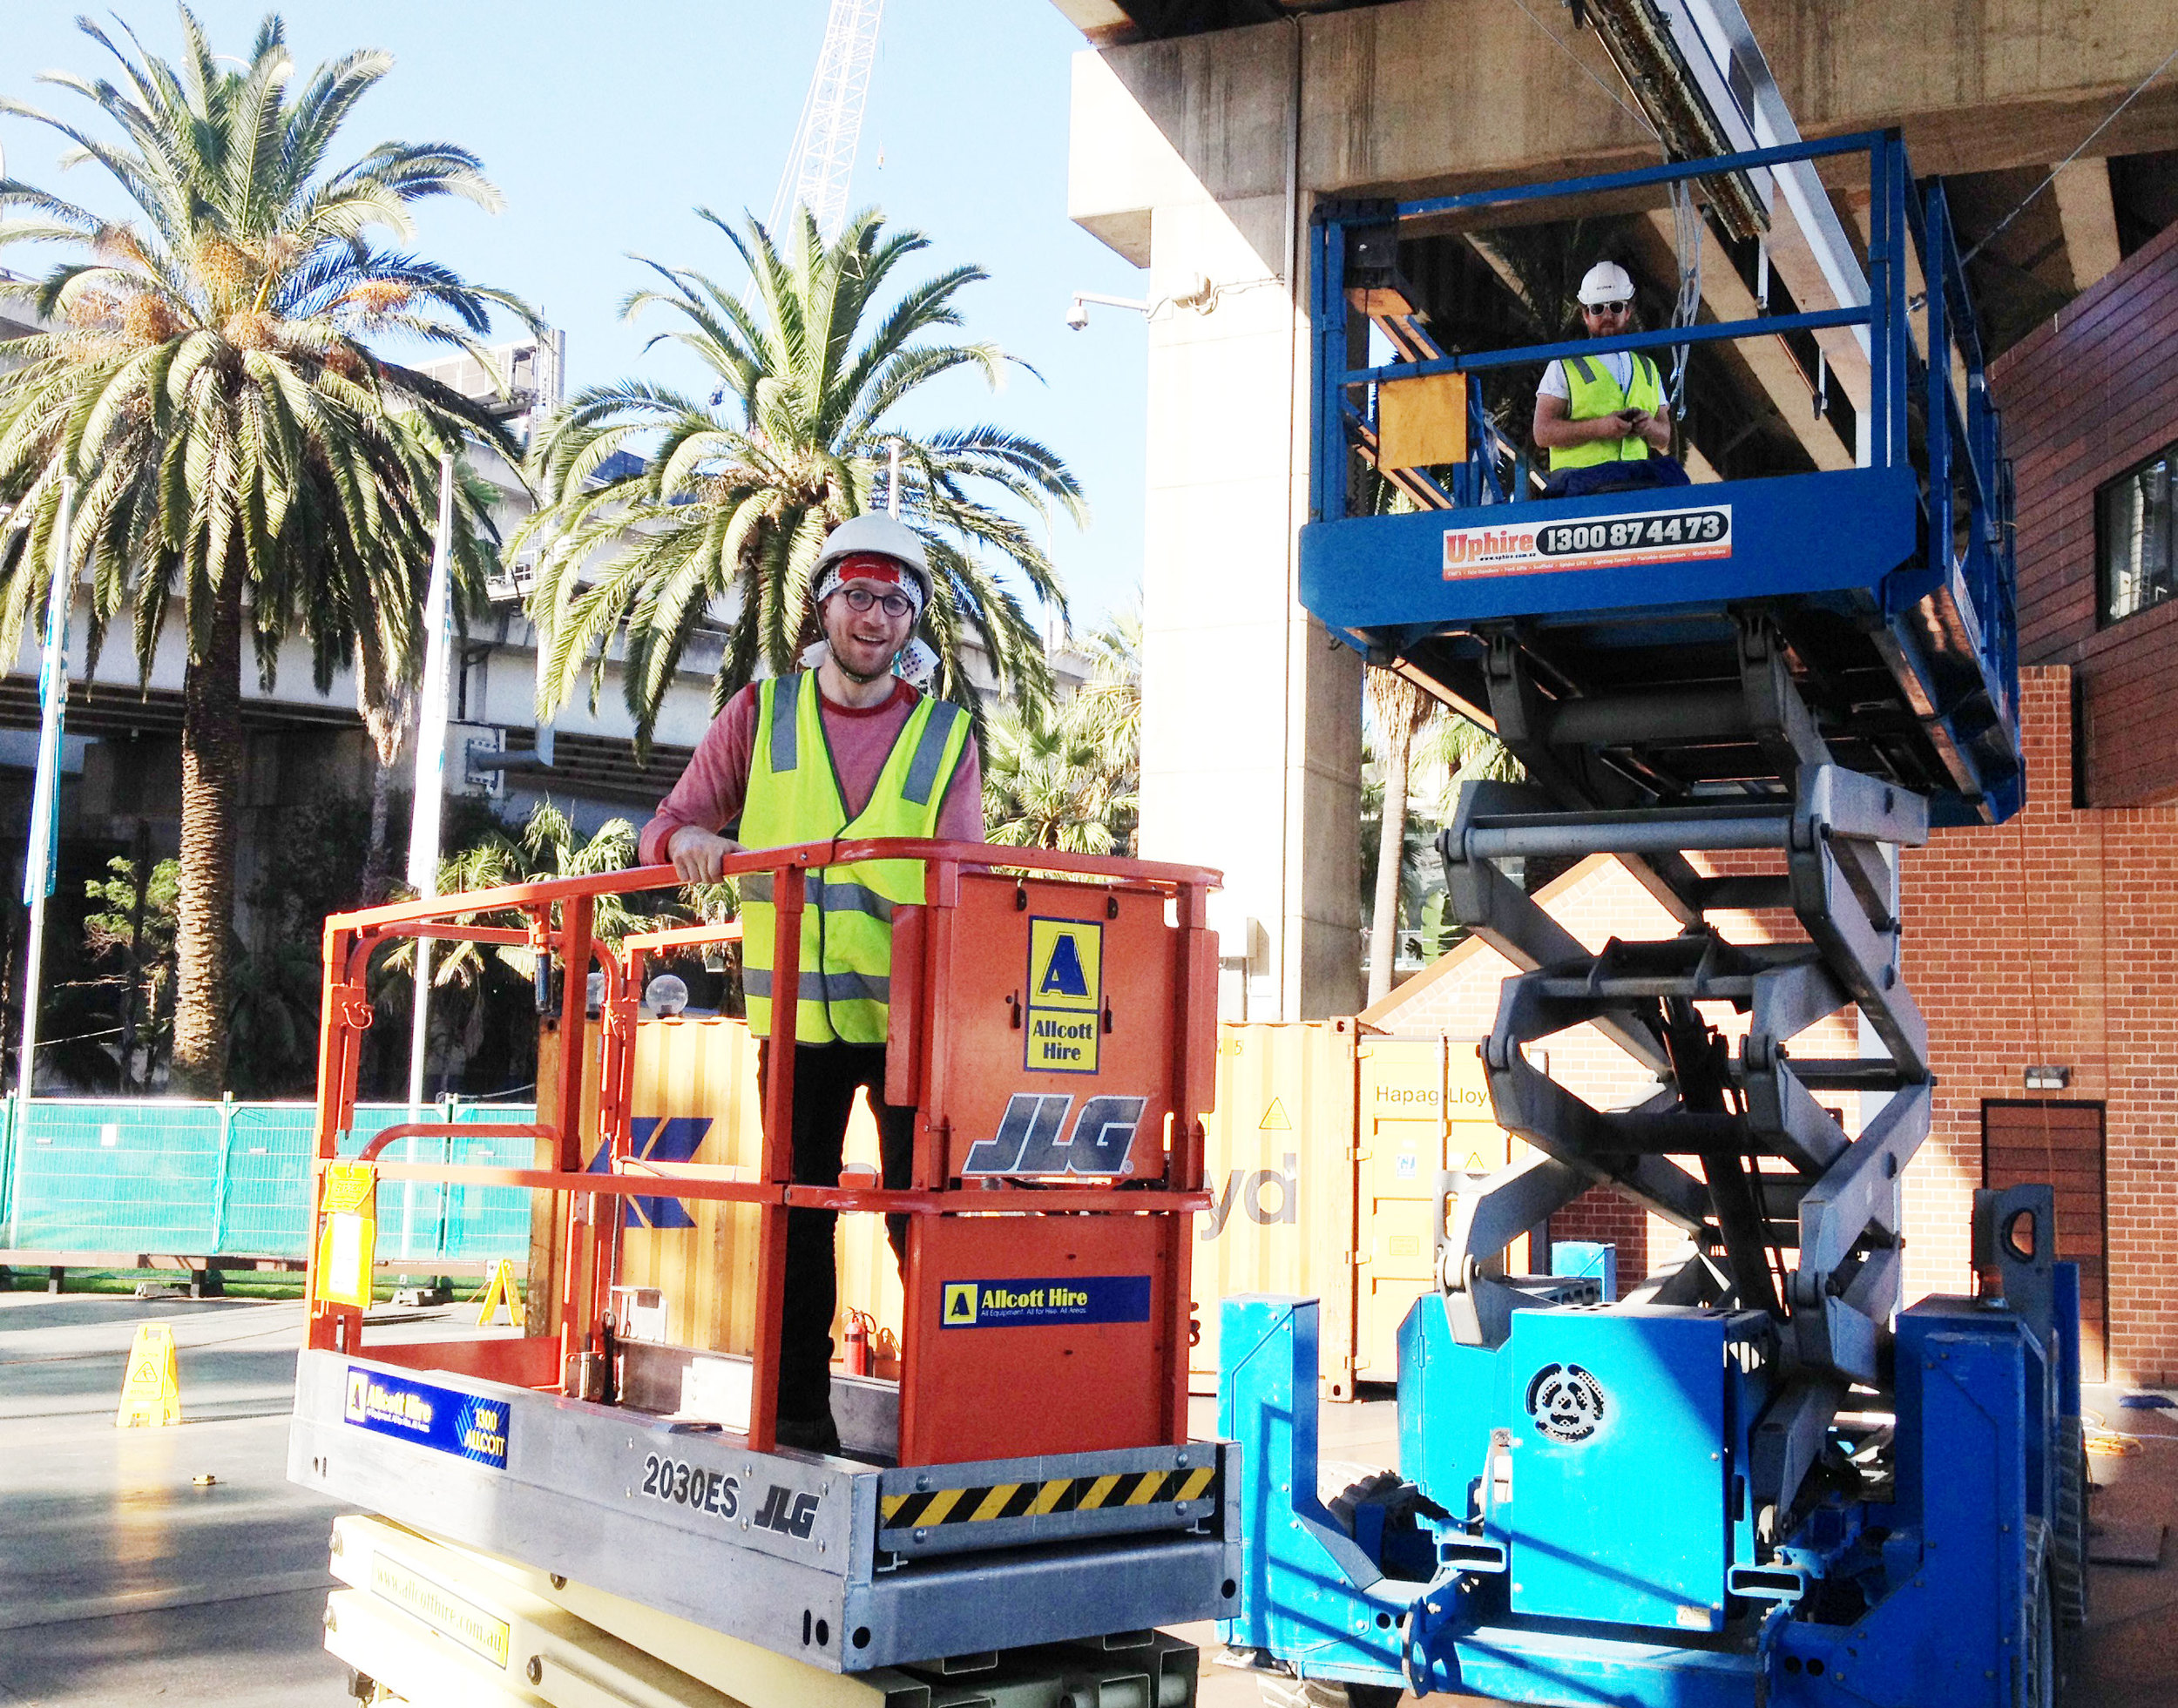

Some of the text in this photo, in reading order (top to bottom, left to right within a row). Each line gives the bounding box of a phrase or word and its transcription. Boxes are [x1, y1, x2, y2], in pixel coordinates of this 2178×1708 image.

[1446, 530, 1533, 564] Uphire
[1547, 515, 1720, 552] 1300 87 44 73
[1032, 1019, 1092, 1040] Allcott
[1043, 1042, 1081, 1061] Hire
[1376, 1085, 1491, 1107] Hapag Lloy
[961, 1093, 1148, 1174] JLG
[981, 1288, 1088, 1309] Allcott Hire
[475, 1408, 498, 1432] 1300
[463, 1429, 505, 1456] ALLCOTT
[641, 1454, 741, 1520] 2030ES
[753, 1484, 821, 1541] JLG
